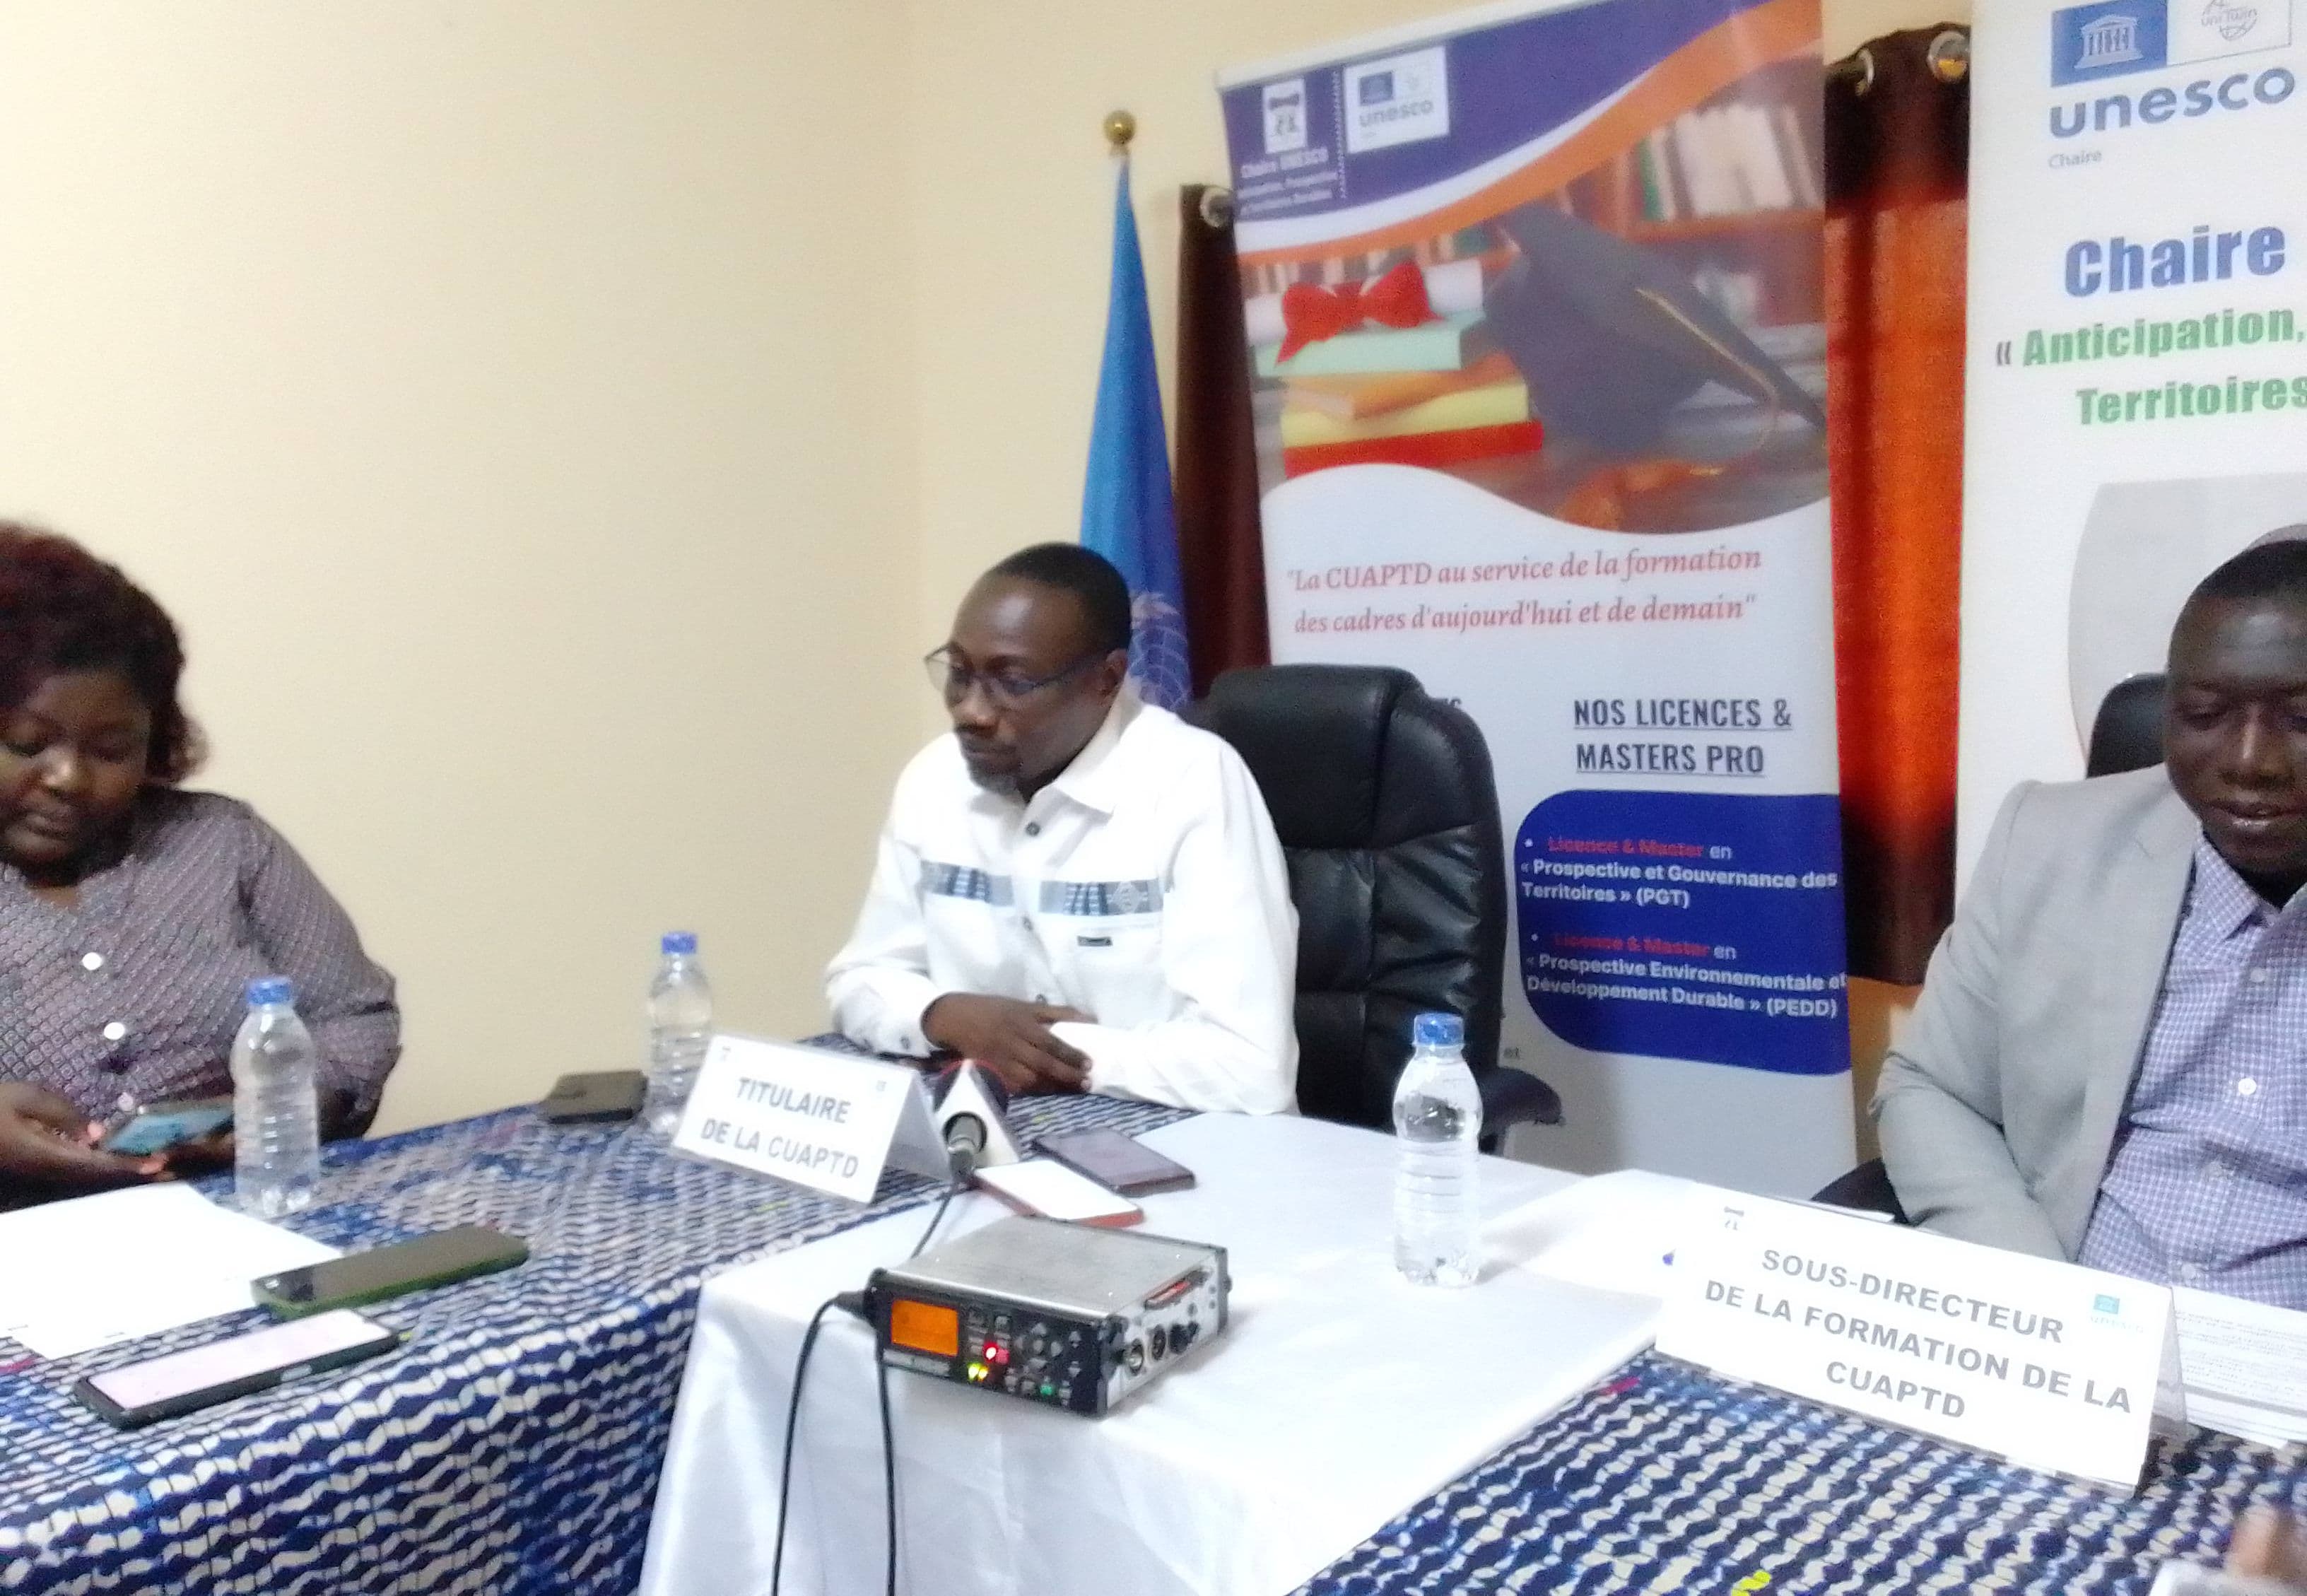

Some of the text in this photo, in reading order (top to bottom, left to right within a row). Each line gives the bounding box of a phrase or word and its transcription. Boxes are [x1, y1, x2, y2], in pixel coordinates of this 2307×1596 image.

[1359, 100, 1433, 127] unesco
[2050, 68, 2295, 138] unesco
[2049, 150, 2102, 169] Chaire
[2065, 225, 2286, 298] Chaire
[2023, 308, 2304, 366] Anticipation,
[2076, 375, 2307, 425] Territoires
[1326, 563, 1432, 589] CUAPTD
[1438, 565, 1466, 583] au
[1471, 556, 1554, 582] service
[1560, 551, 1588, 577] de
[1595, 549, 1618, 575] la
[1621, 544, 1761, 582] formation
[1295, 610, 1327, 633] des
[1333, 606, 1405, 633] cadres
[1411, 599, 1571, 634] d'aujourd'hui
[1578, 602, 1600, 623] et
[1607, 597, 1636, 622] de
[1573, 699, 1792, 727] NOS LICENCES &
[1576, 744, 1764, 774] MASTERS PRO
[1532, 859, 1641, 881] Prospective
[1645, 865, 1664, 879] et
[1667, 865, 1797, 888] Gouvernance
[1802, 871, 1838, 888] des
[1709, 845, 1732, 859] en
[1522, 881, 1616, 902] Territoires
[1636, 888, 1691, 910] (PGT)
[1539, 954, 1647, 977] Prospective
[1650, 963, 1824, 991] Environnementale
[1828, 971, 1848, 989] et
[1713, 946, 1737, 960] en
[1527, 976, 1667, 1002] Développement
[1672, 987, 1744, 1011] Durable
[1767, 998, 1838, 1019] (PEDD)
[736, 1077, 851, 1123] TITULAIRE
[700, 1119, 858, 1178] DE LA CUAPTD
[1761, 1249, 2065, 1343] SOUS-DIRECTEUR
[1705, 1281, 2132, 1414] DE LA FORMATION DE LA
[1825, 1361, 1966, 1419] CUAPTD
